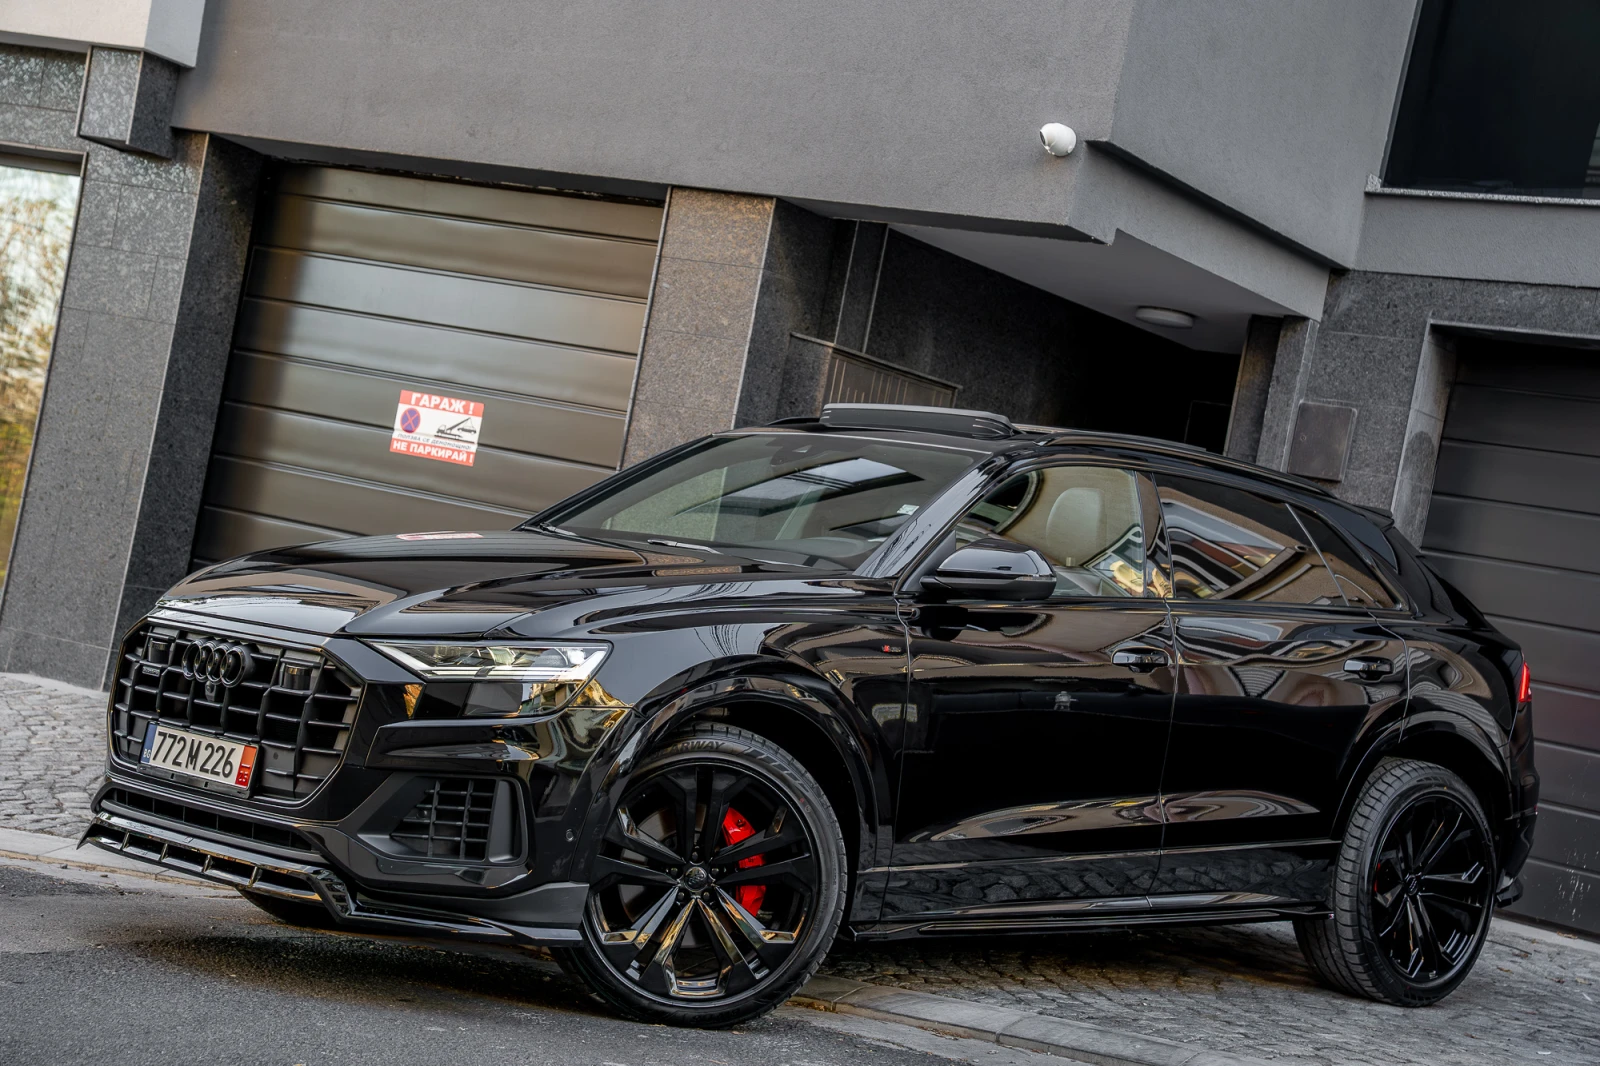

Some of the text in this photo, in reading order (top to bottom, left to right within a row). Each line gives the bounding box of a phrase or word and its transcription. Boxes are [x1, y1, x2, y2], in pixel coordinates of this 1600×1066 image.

[411, 393, 475, 415] ГАРАЖ !
[392, 440, 408, 451] НЕ
[409, 443, 468, 462] ПАРКИРАЙ
